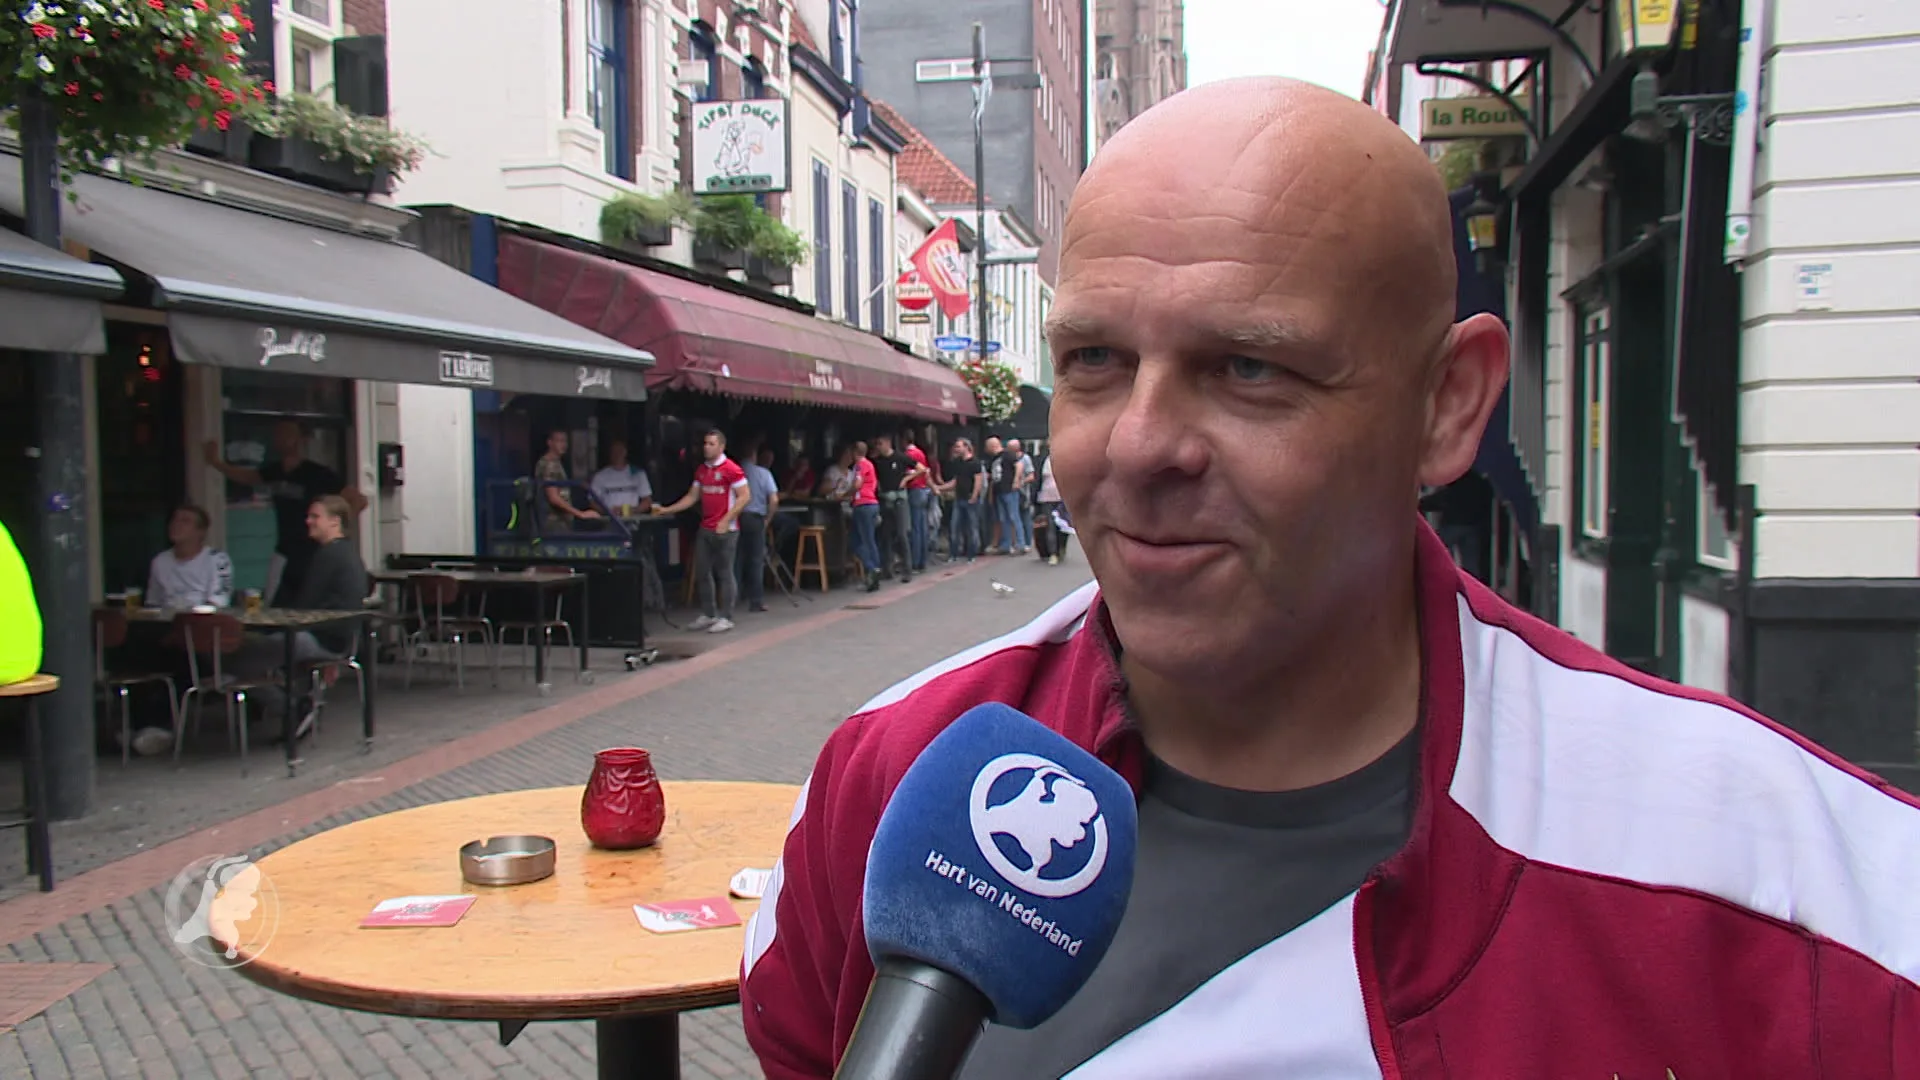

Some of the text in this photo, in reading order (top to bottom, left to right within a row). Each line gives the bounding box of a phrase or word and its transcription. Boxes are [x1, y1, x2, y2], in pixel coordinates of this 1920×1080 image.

[741, 103, 780, 130] DUCK
[1431, 107, 1529, 126] la Rout
[925, 849, 1084, 958] Hart van Nederland
